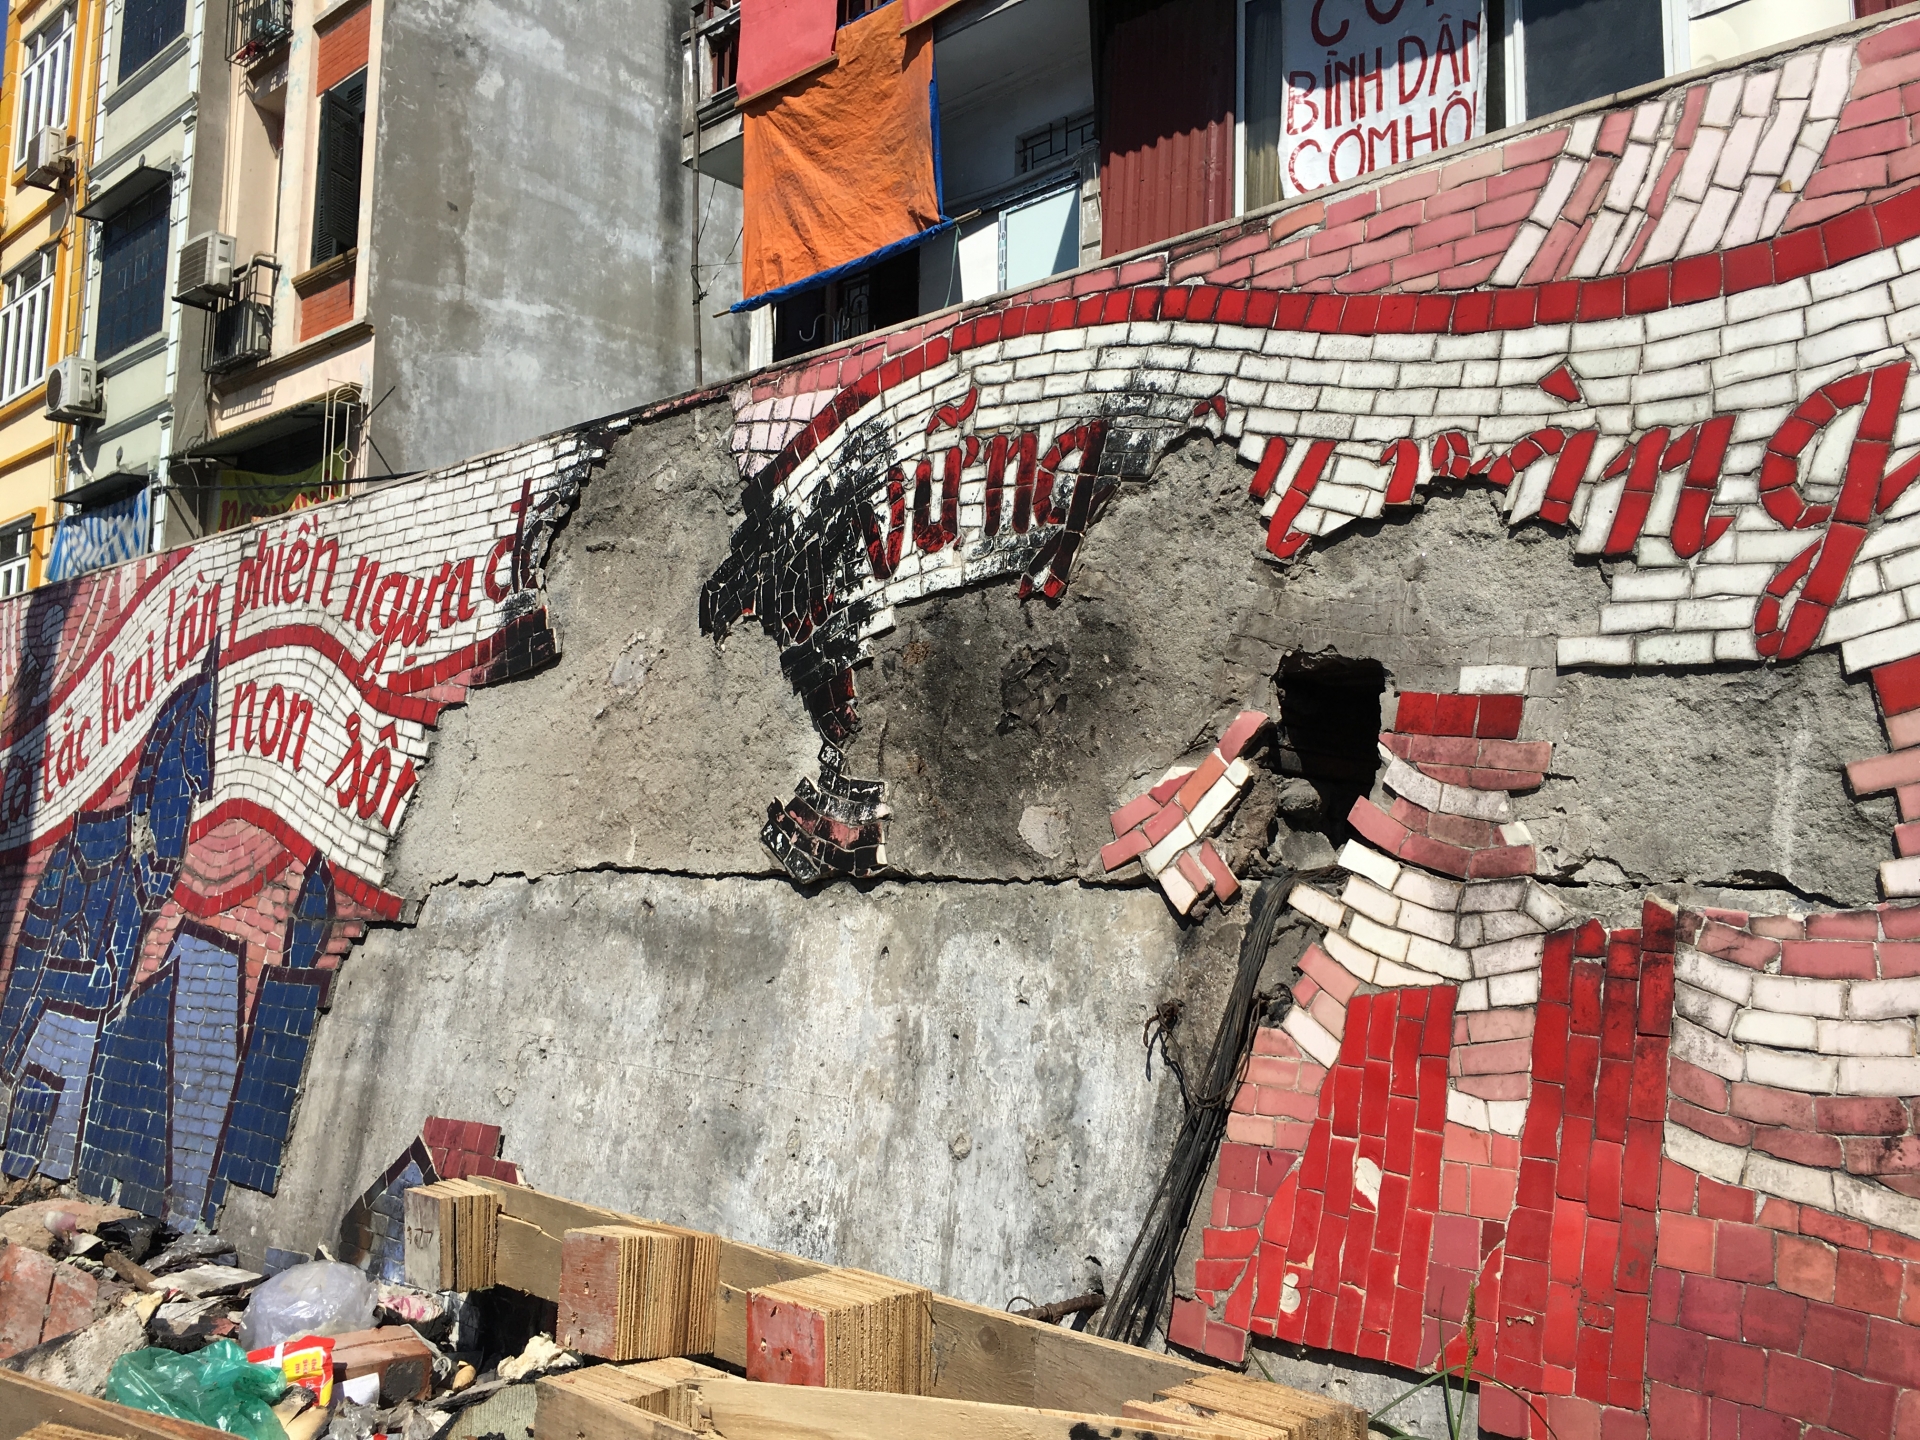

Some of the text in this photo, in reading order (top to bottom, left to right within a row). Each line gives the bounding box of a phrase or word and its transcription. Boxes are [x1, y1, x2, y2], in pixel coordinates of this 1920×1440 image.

[1397, 13, 1481, 105] DÂN
[101, 630, 156, 747] hai
[163, 570, 222, 683] lần
[228, 514, 340, 652] phiền
[342, 555, 477, 691] ngựa
[228, 680, 312, 772] non
